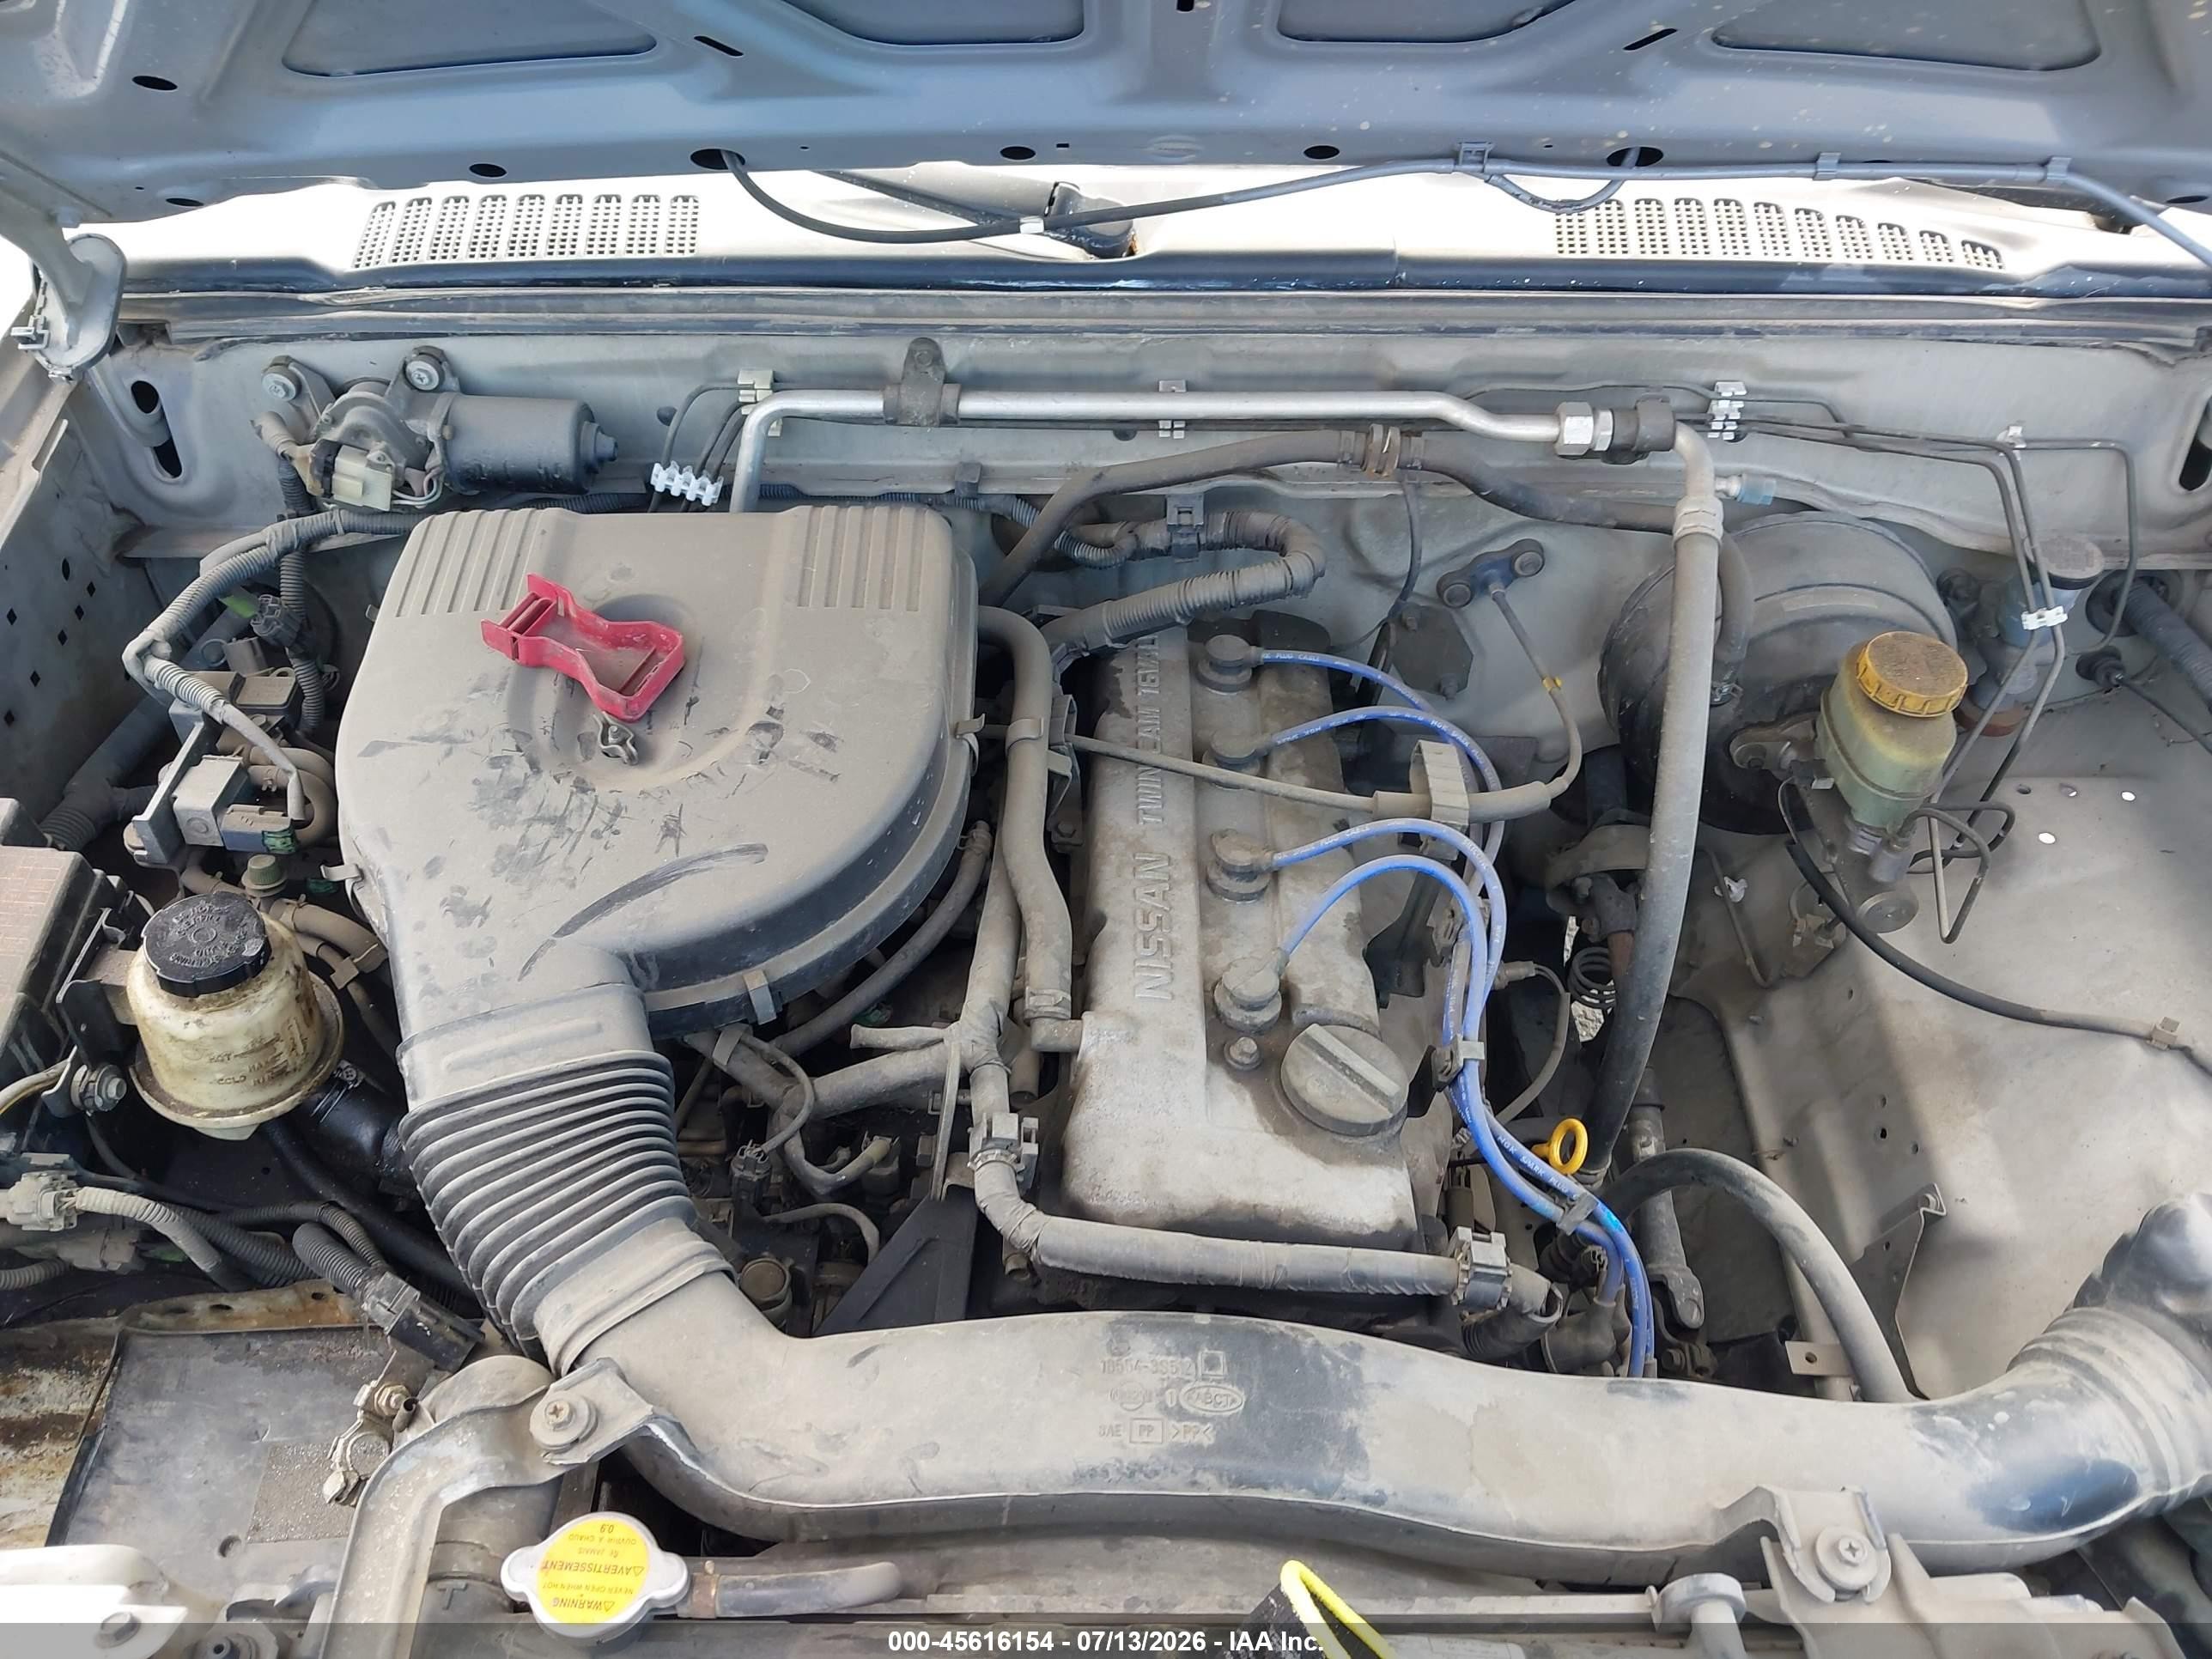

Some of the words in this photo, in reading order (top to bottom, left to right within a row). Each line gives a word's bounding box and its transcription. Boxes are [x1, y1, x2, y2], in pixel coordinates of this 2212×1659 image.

[1135, 769, 1164, 826] TWIN
[1133, 852, 1175, 1002] NISSAN
[1519, 1154, 1546, 1177] SPARK
[599, 1523, 615, 1534] 0.9
[541, 1559, 633, 1576] AVERTISSEMENT
[585, 1584, 607, 1593] OPEN
[551, 1596, 603, 1612] WARNING
